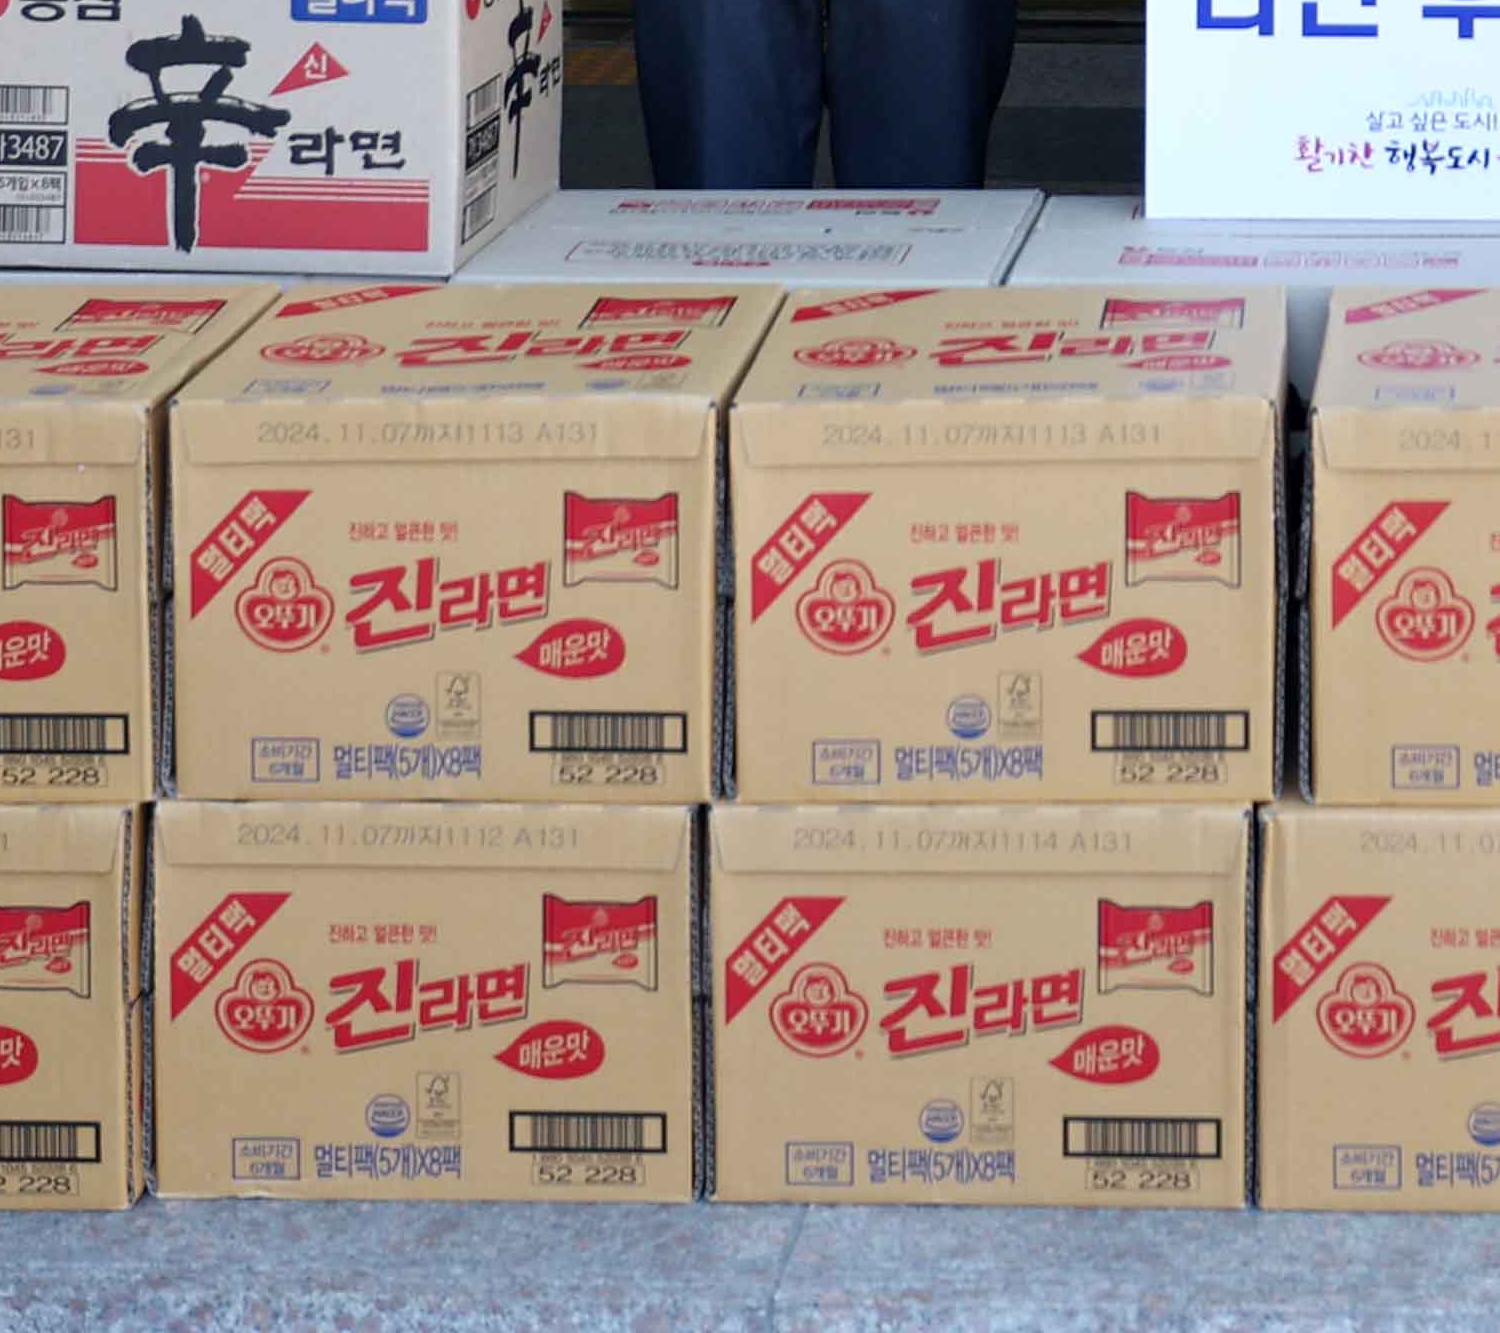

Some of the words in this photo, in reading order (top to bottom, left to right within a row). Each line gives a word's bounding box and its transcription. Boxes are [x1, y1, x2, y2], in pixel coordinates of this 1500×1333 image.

[109, 13, 292, 252] 辛
[1365, 111, 1404, 131] 살고
[1410, 111, 1448, 131] 싶은
[1453, 111, 1499, 131] 도시!
[1295, 136, 1375, 170] 활기찬
[1384, 137, 1491, 171] 행복도시
[346, 557, 551, 656] 진라면
[539, 634, 609, 669] 매운맛
